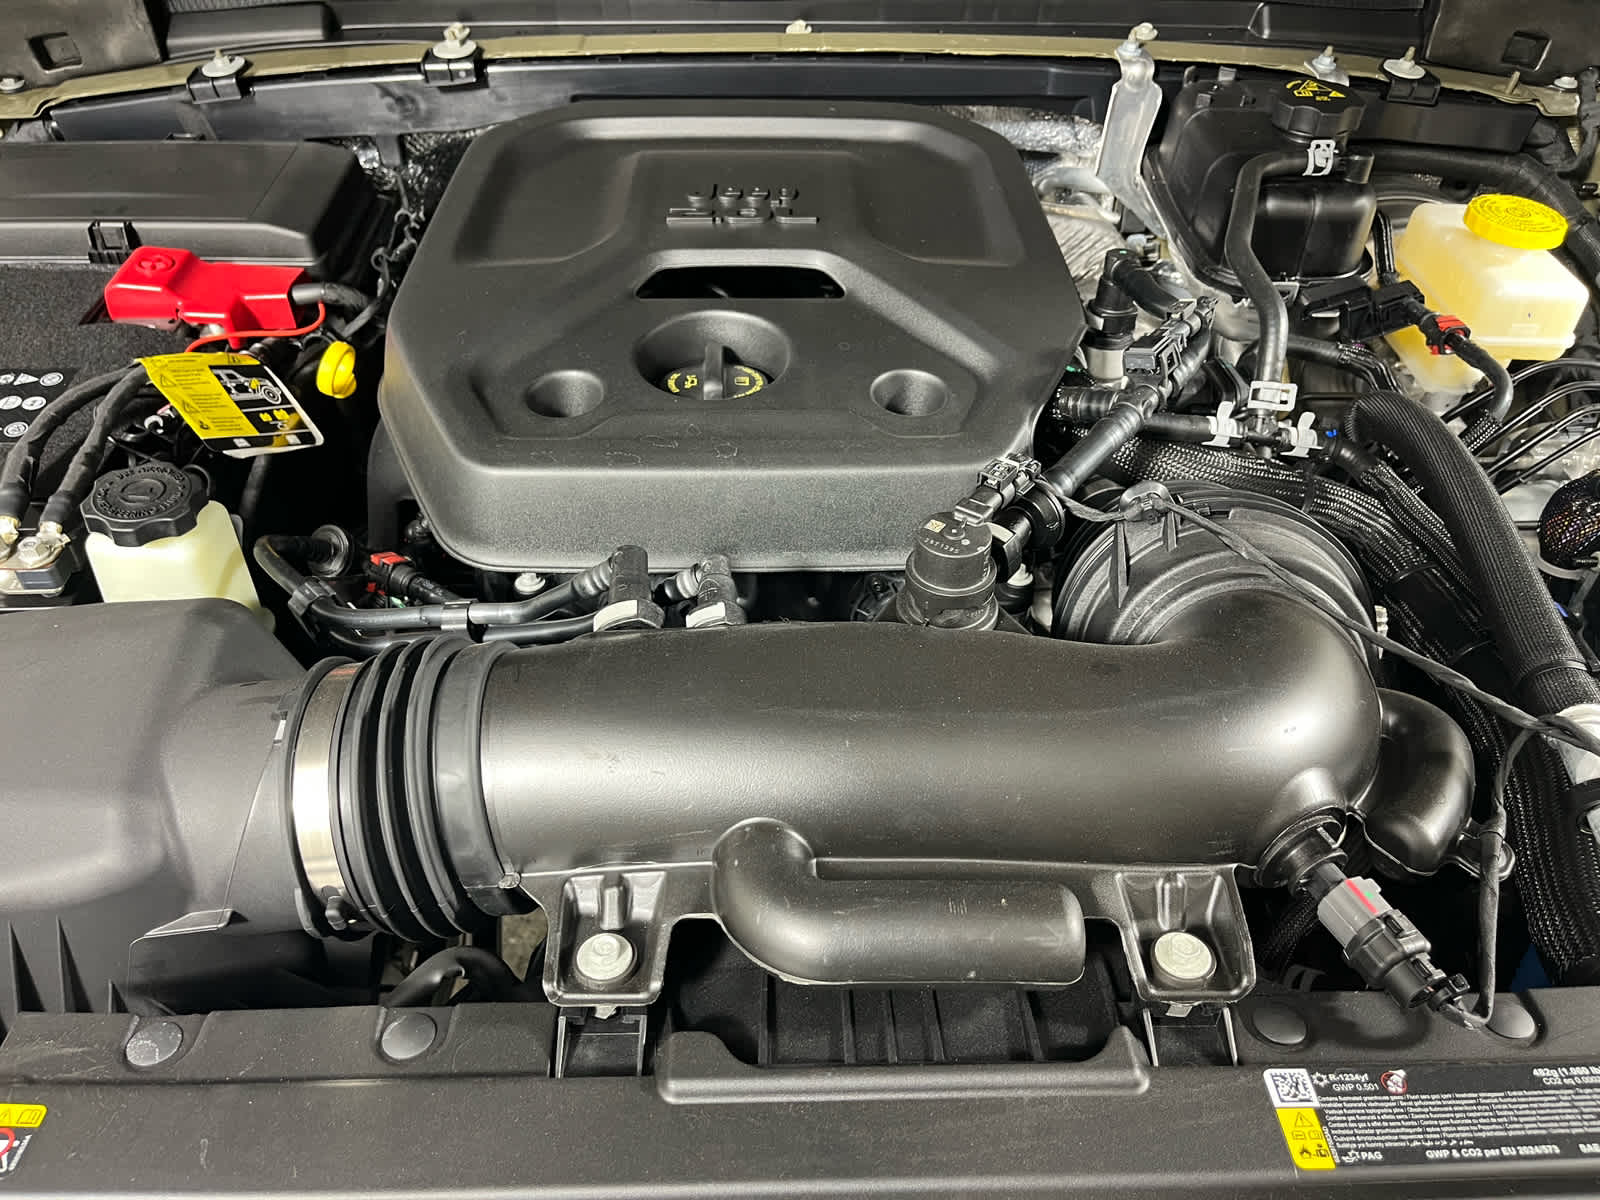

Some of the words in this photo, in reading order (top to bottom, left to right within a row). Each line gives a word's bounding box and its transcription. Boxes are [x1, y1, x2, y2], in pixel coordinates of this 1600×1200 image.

[687, 183, 799, 208] Jeep
[1328, 1073, 1369, 1082] R-1234yf
[1542, 1077, 1562, 1085] CO2
[1332, 1083, 1355, 1091] GWP
[1355, 1083, 1379, 1091] 0.501
[1360, 1151, 1383, 1160] PAG
[1425, 1149, 1450, 1158] GWP
[1461, 1148, 1483, 1157] CO2
[1500, 1146, 1517, 1156] EU
